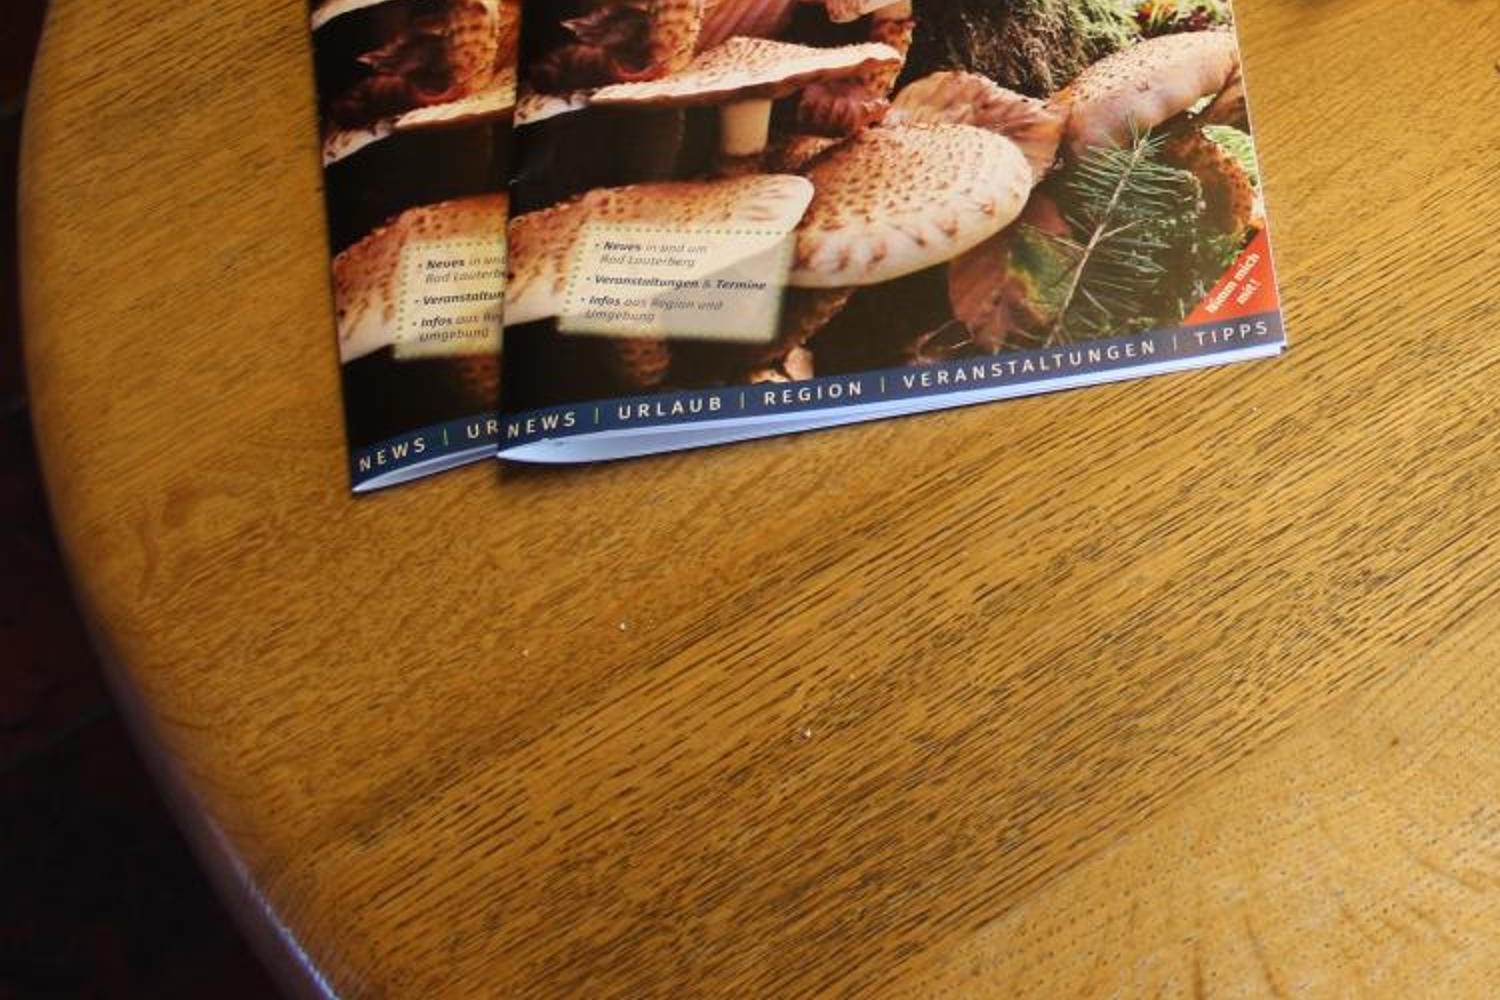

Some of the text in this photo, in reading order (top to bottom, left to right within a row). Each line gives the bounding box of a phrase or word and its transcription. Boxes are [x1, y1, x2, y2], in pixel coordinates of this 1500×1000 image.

[604, 241, 641, 251] Neues
[427, 259, 464, 270] Neues
[594, 274, 699, 290] Veranstaltungen
[715, 279, 767, 290] Termine
[589, 295, 621, 307] Infos
[421, 315, 452, 328] Infos
[585, 309, 655, 323] Umgebung
[419, 328, 489, 342] Umgebung
[507, 320, 1268, 441] NEWS URLAUB REGION VERANSTALTUNGEN TIPPS
[358, 436, 427, 474] NEWS
